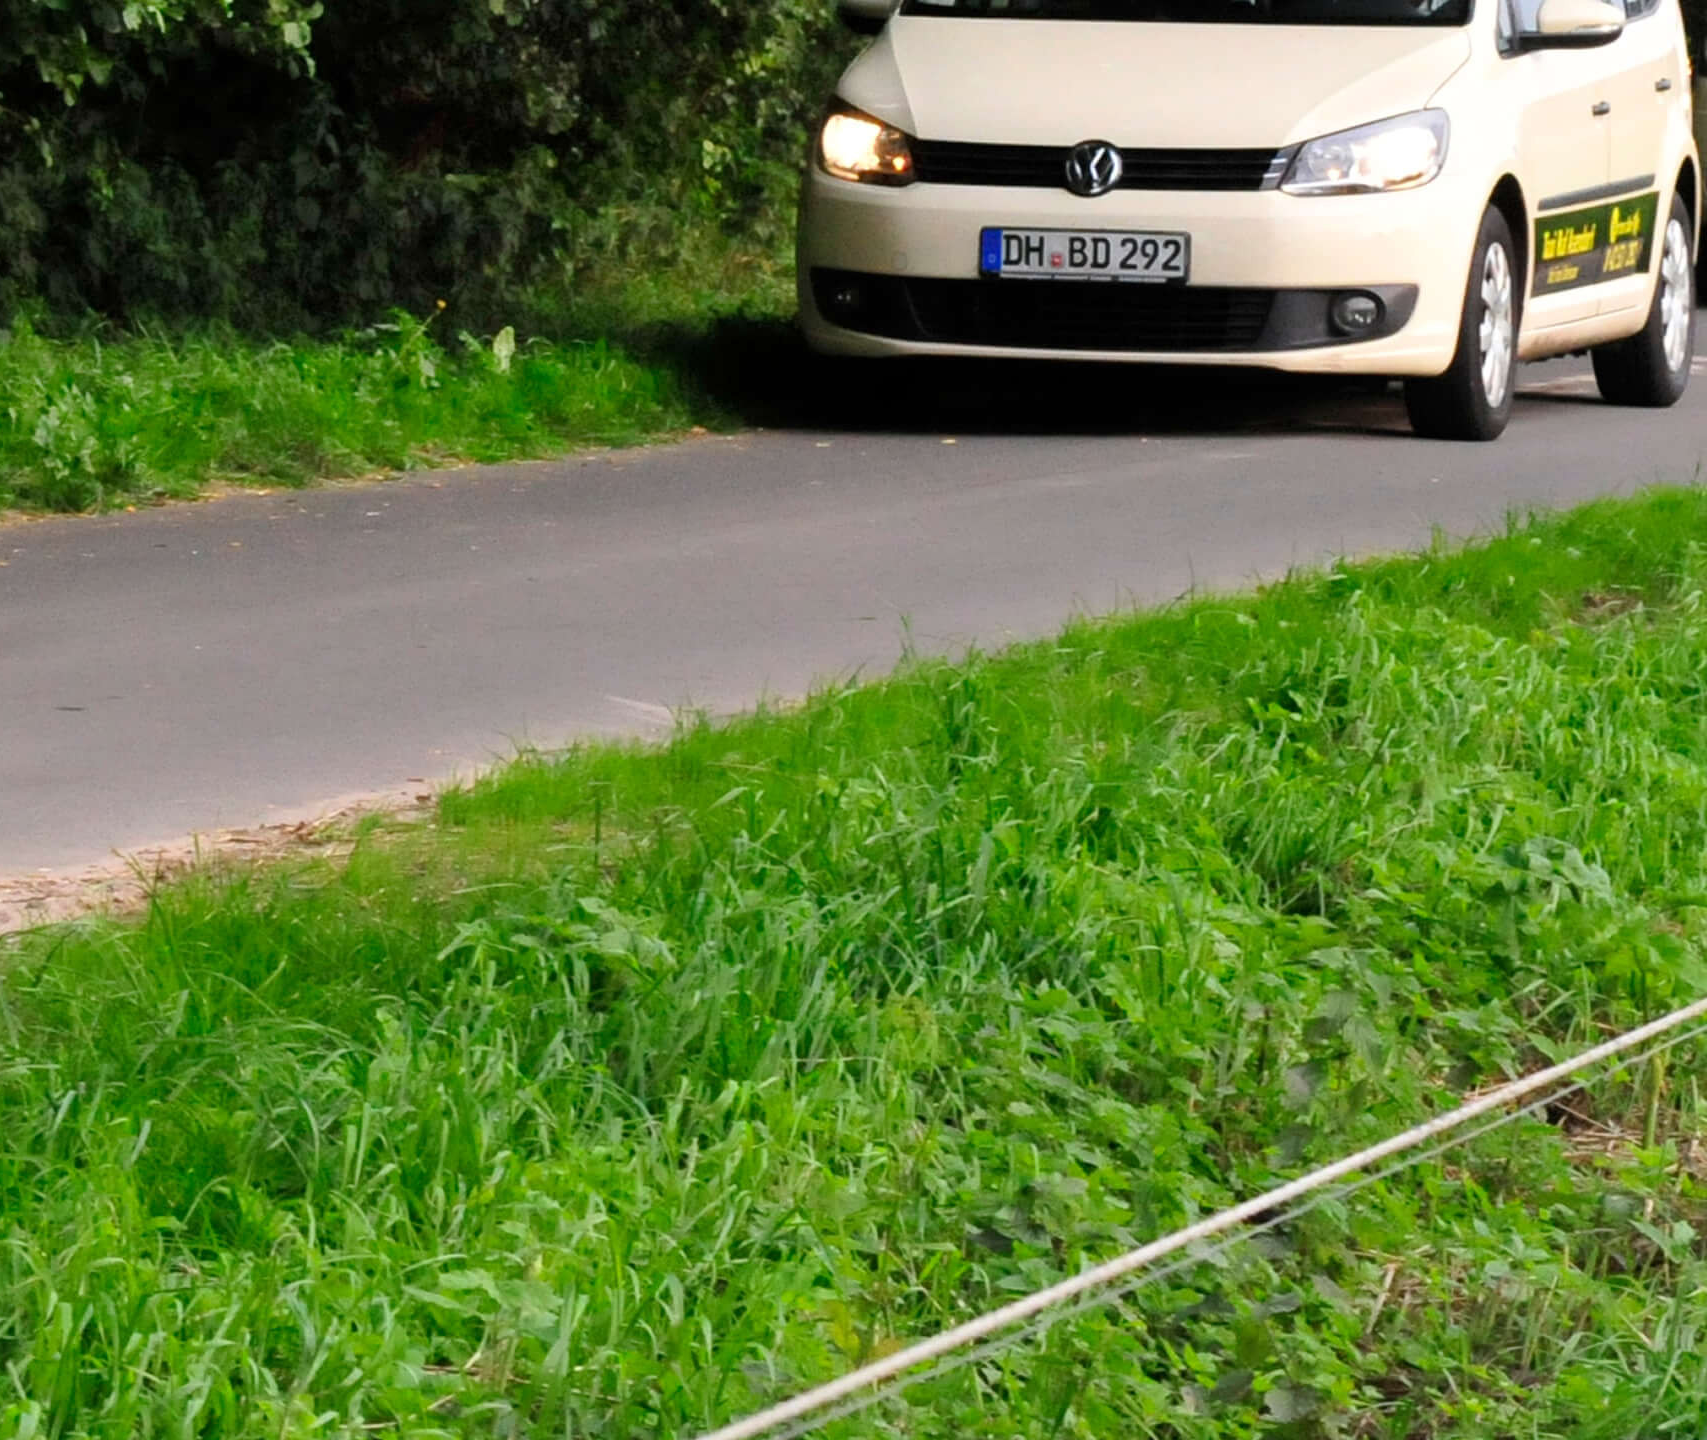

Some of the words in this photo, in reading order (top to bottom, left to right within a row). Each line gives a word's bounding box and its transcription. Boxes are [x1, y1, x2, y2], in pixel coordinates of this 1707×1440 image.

[1003, 234, 1044, 267] DH
[1068, 236, 1111, 269] BD
[1119, 238, 1181, 271] 292
